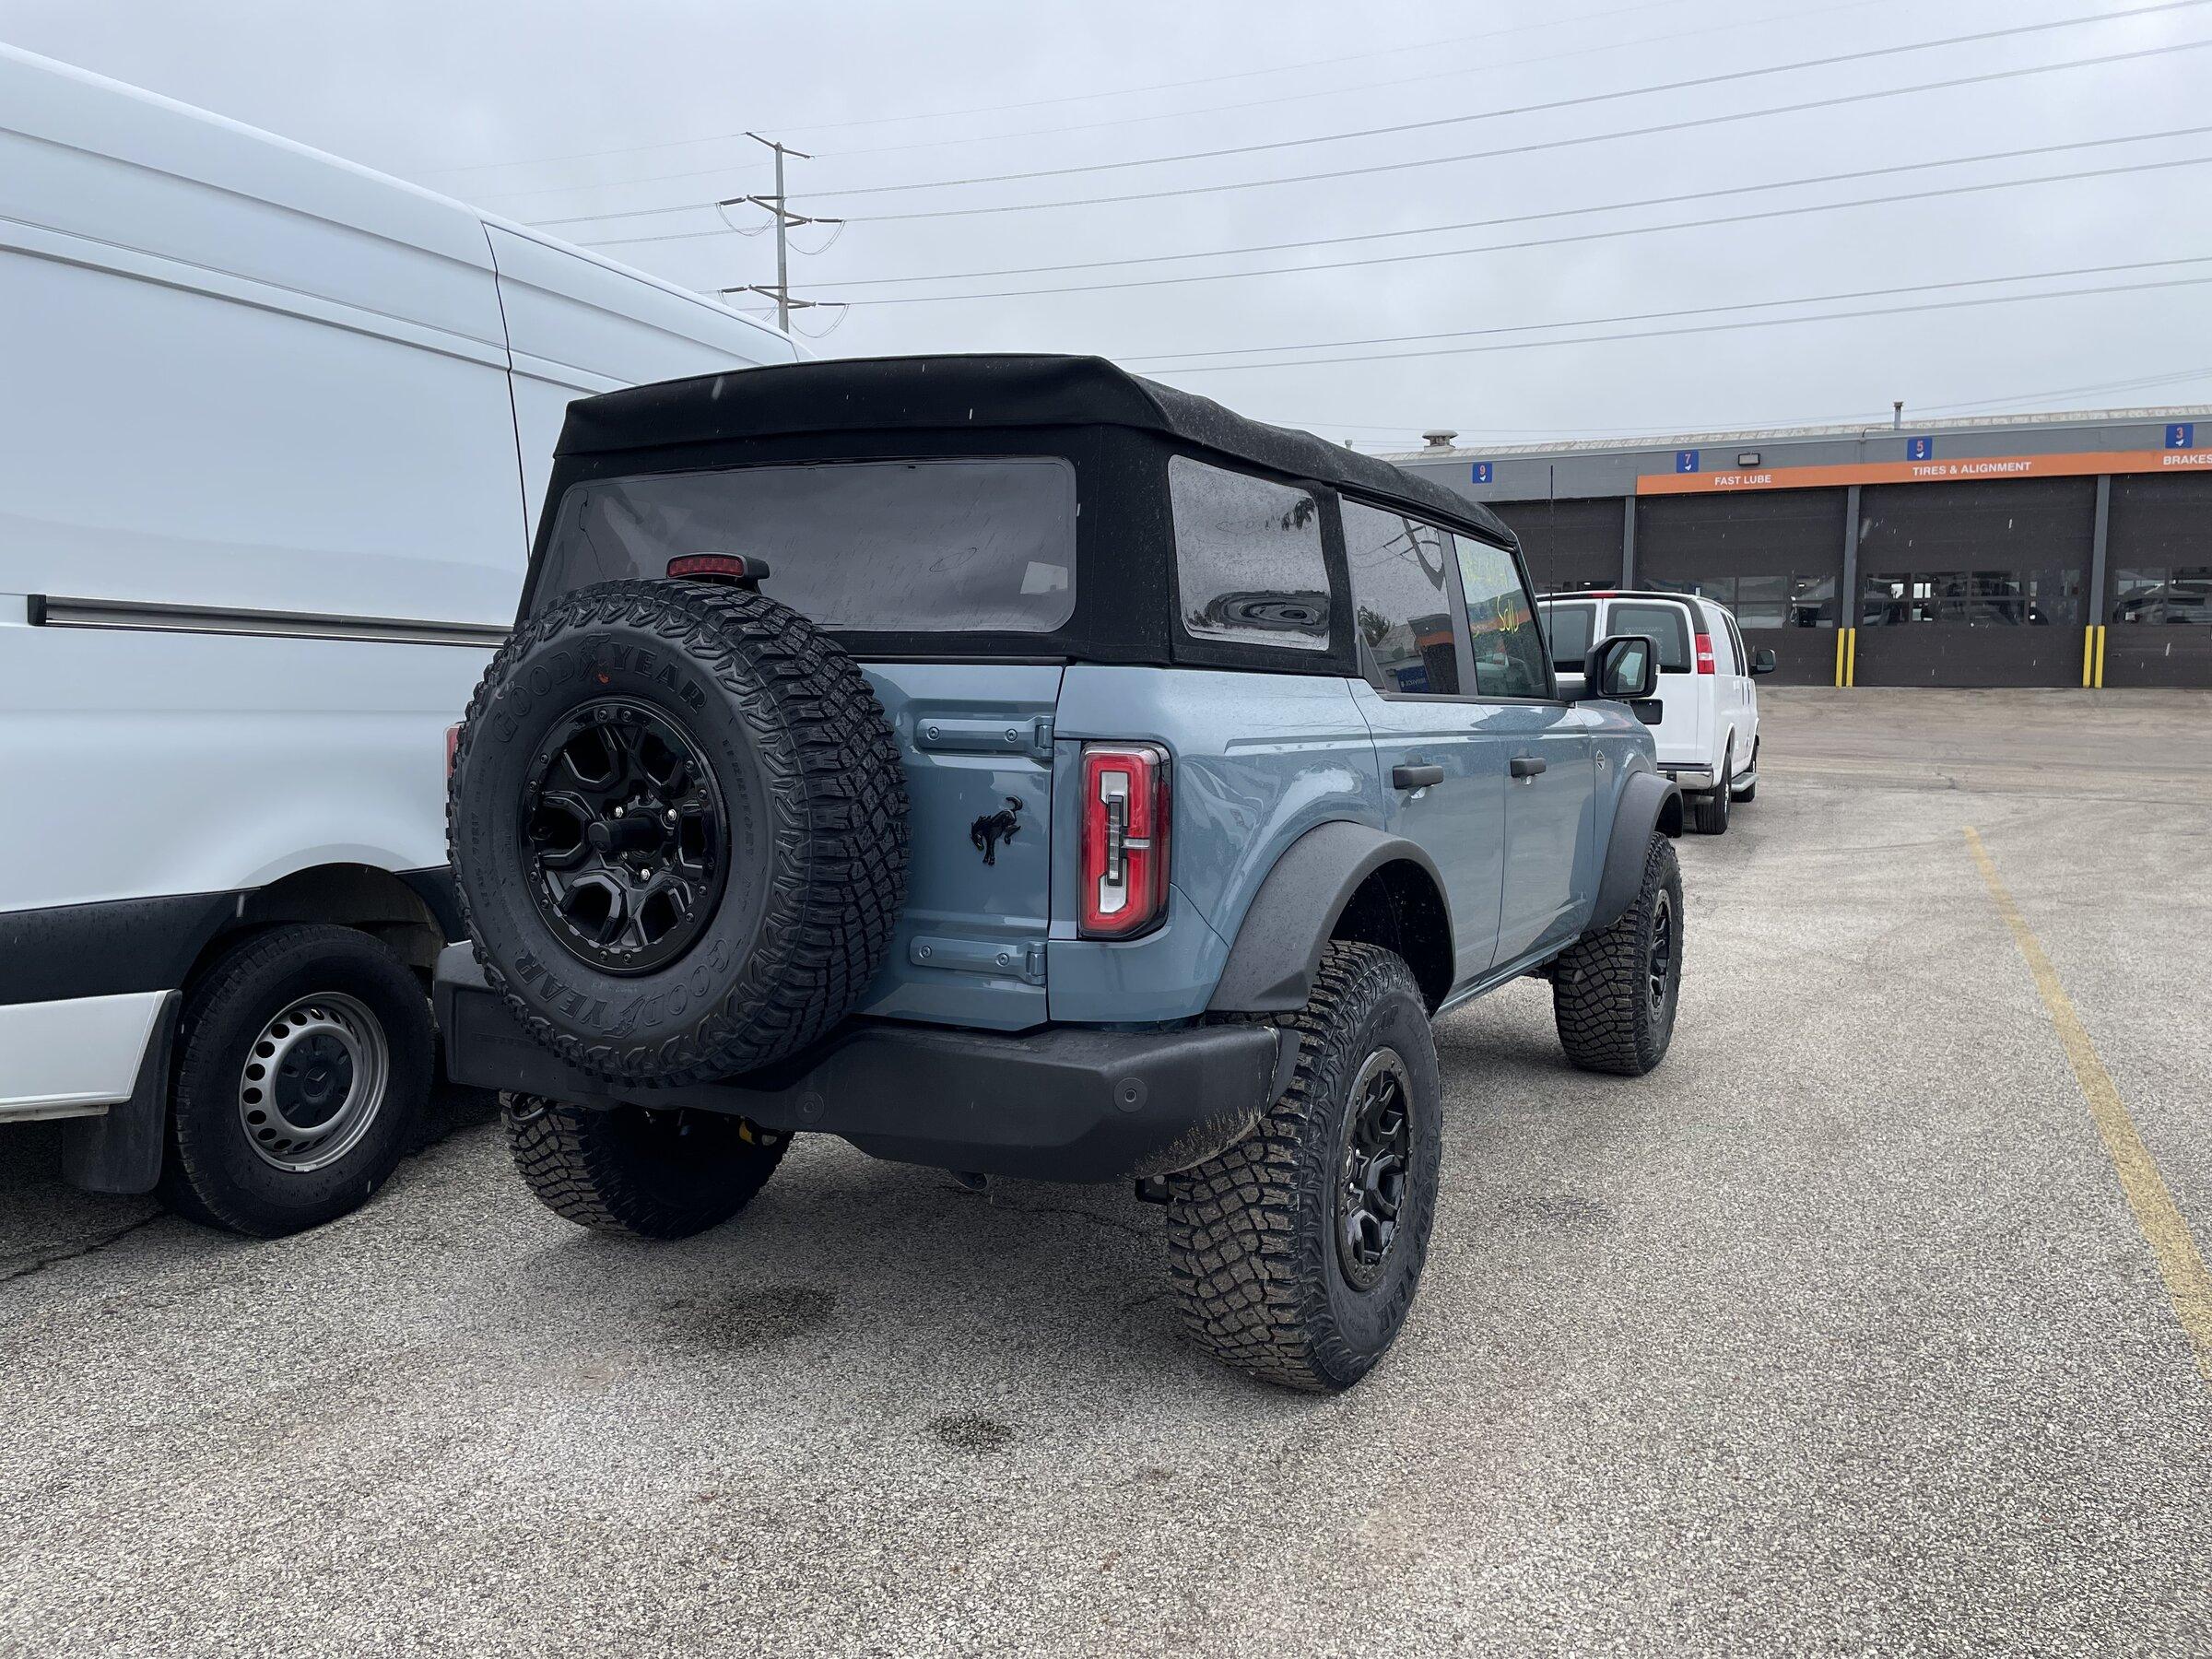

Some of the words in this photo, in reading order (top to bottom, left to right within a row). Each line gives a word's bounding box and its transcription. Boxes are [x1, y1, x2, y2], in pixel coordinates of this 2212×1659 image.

[2176, 427, 2183, 439] 3
[1916, 440, 1924, 452] 5
[1685, 453, 1691, 465] 7
[2163, 453, 2212, 465] BRAKES
[1479, 465, 1486, 476] 9
[1912, 466, 1947, 477] TIRES
[1949, 465, 1958, 475] &
[1960, 462, 2032, 474] ALIGNMENT
[1714, 476, 1741, 486] FAST
[1744, 475, 1771, 484] LUBE
